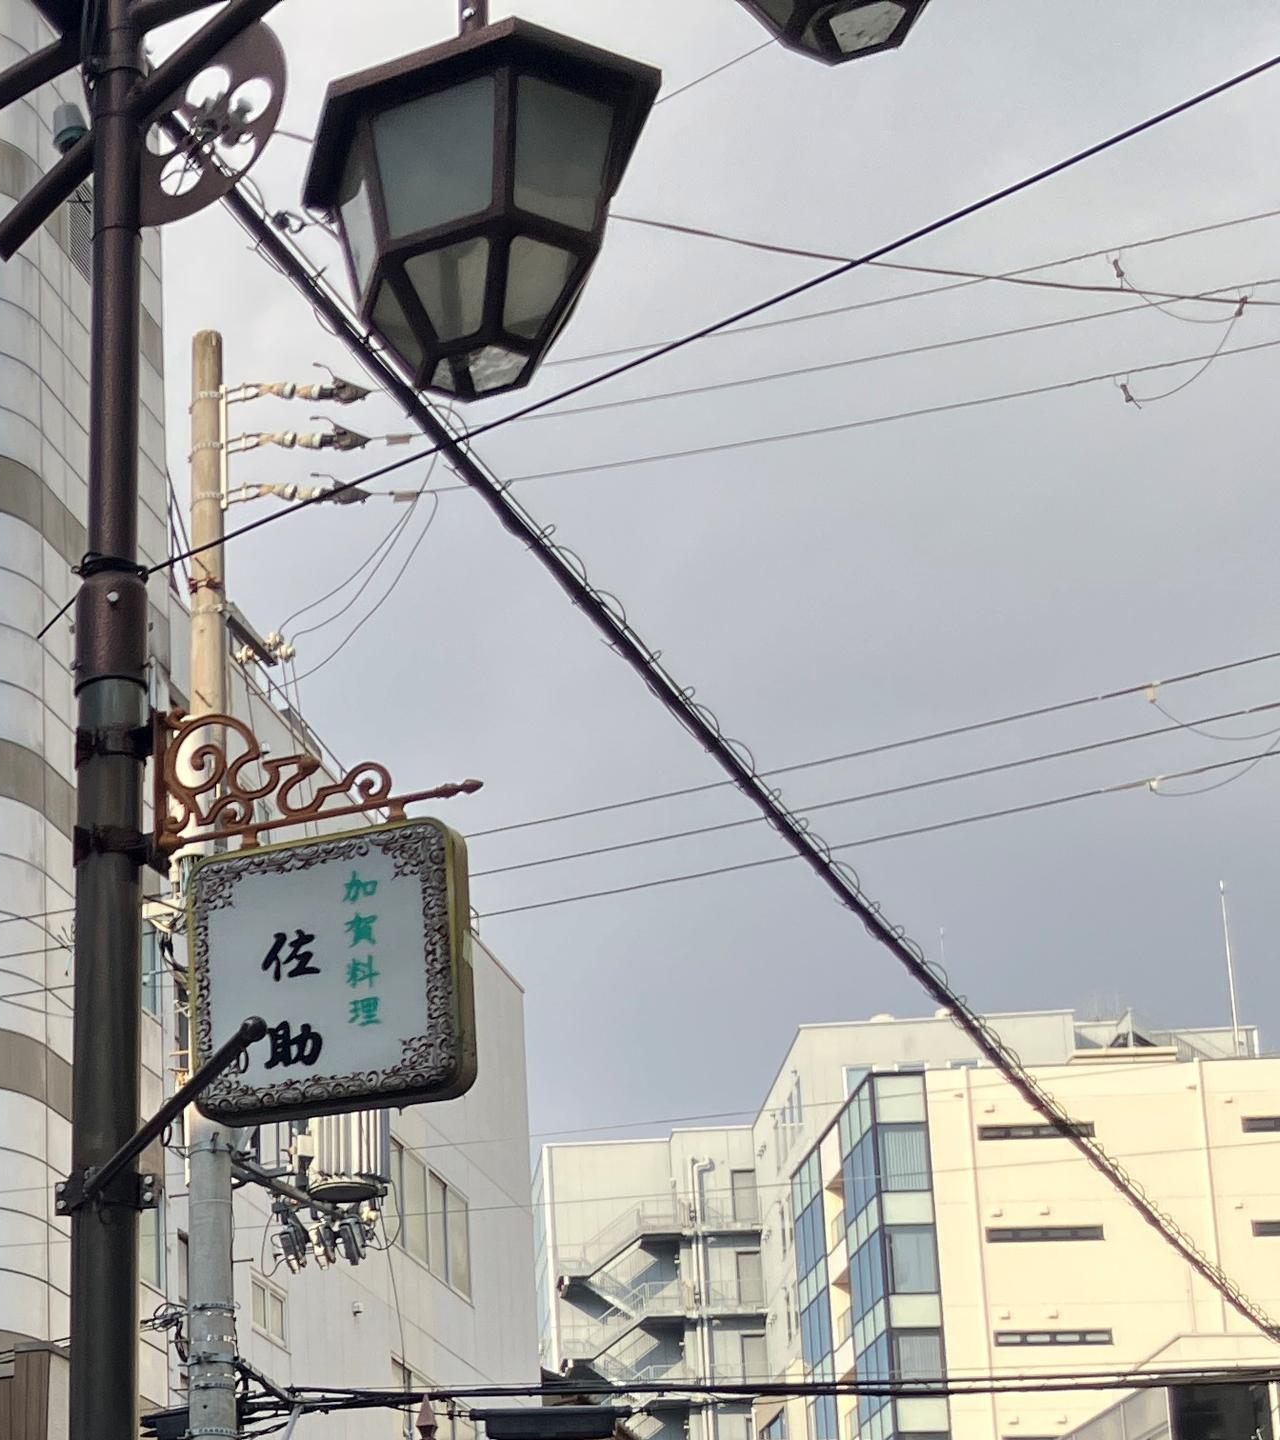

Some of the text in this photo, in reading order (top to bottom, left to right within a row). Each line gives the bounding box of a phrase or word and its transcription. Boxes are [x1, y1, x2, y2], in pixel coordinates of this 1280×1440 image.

[261, 929, 324, 1070] 佐助
[342, 870, 382, 1027] 加賀料理
